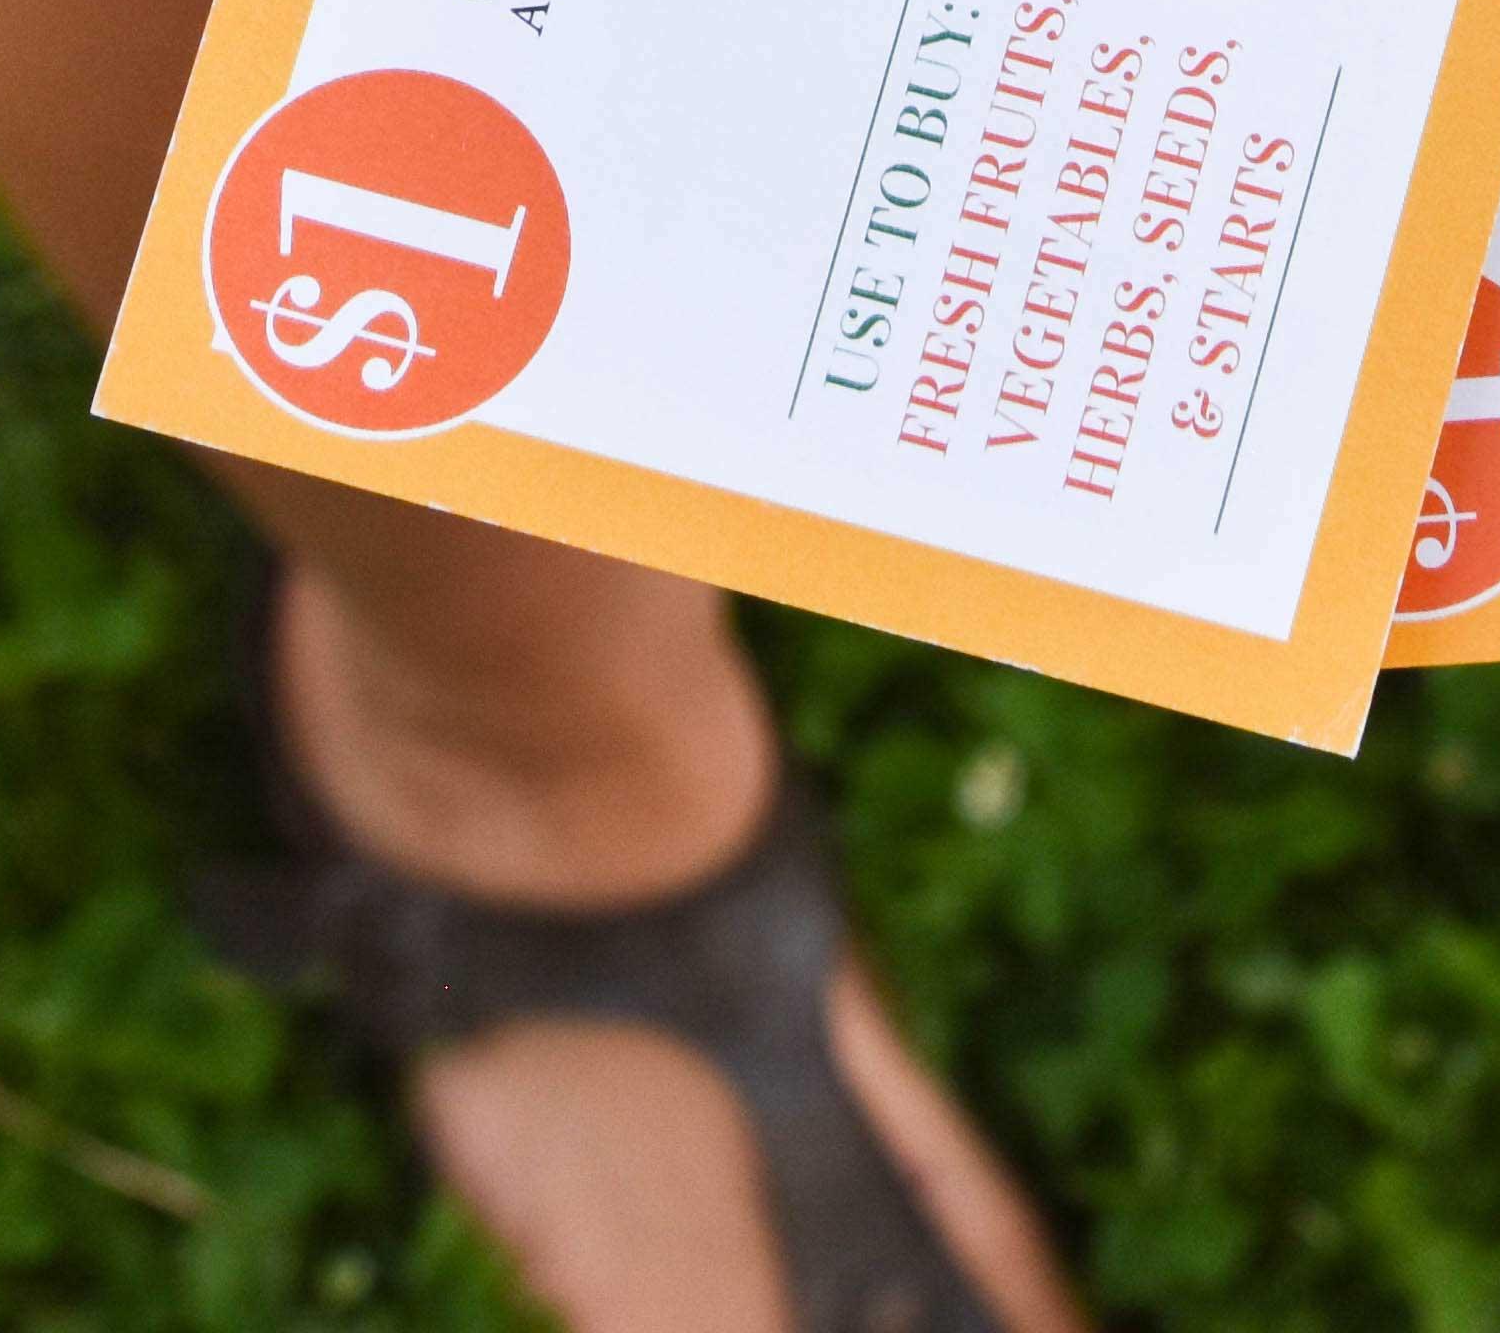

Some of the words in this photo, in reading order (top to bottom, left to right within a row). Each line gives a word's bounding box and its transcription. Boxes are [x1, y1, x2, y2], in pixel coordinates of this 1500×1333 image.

[893, 2, 981, 150] BUY:
[249, 165, 528, 394] $1
[863, 163, 932, 247] TO
[984, 35, 1156, 451] VEGETABLES,
[1062, 273, 1177, 501] HERBS,
[1132, 39, 1244, 252] SEEDS,
[1188, 132, 1295, 375] STARTS
[823, 265, 906, 393] USE
[897, 240, 1002, 457] FRESH
[1171, 388, 1223, 440] &
